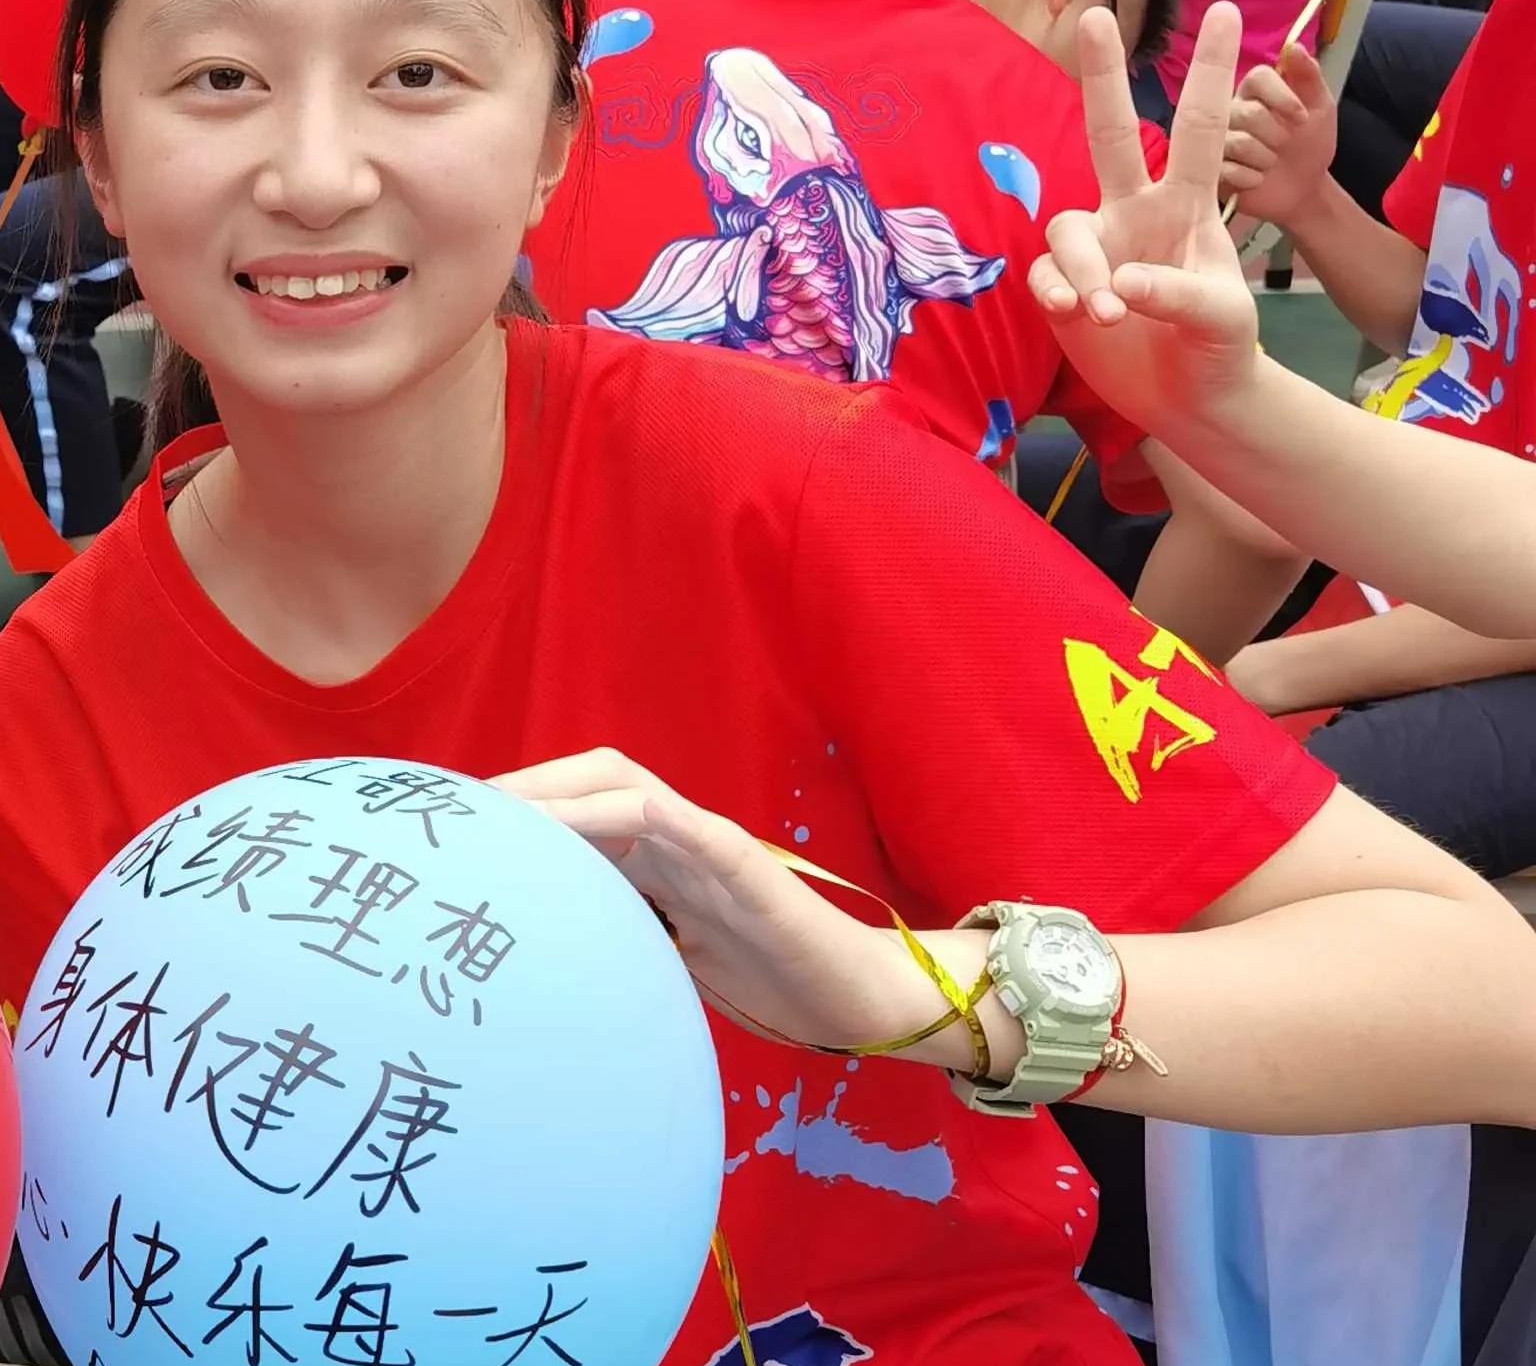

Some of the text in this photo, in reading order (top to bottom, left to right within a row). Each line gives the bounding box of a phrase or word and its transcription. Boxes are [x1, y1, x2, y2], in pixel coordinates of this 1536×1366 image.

[111, 804, 517, 1026] 成绩理想
[25, 918, 462, 1218] 身体健康
